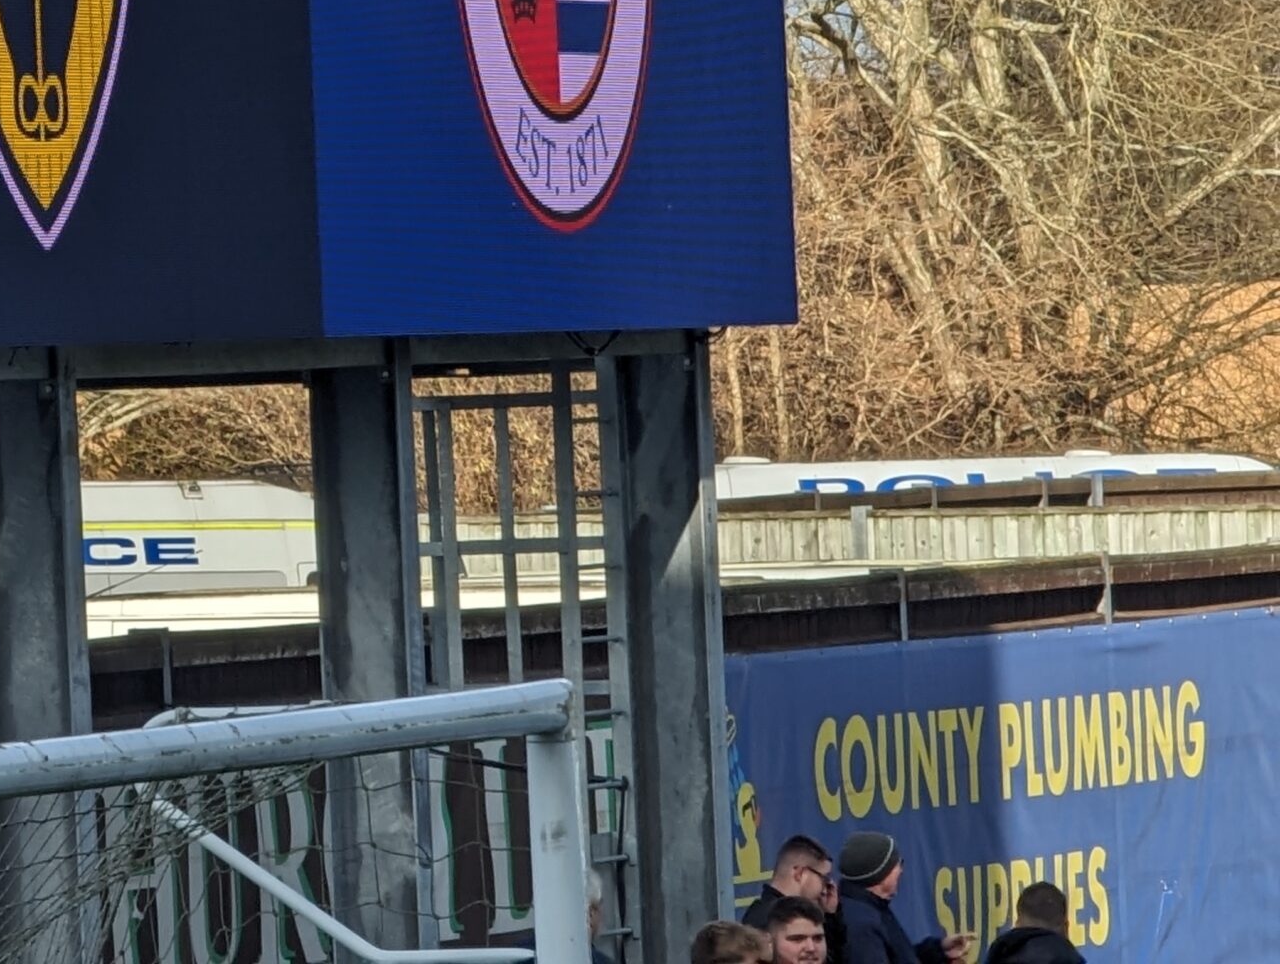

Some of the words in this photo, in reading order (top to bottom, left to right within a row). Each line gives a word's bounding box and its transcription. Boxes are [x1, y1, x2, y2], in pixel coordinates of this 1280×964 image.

[567, 115, 609, 193] 1871
[814, 706, 984, 821] COUNTY
[999, 680, 1205, 800] PLUMBING
